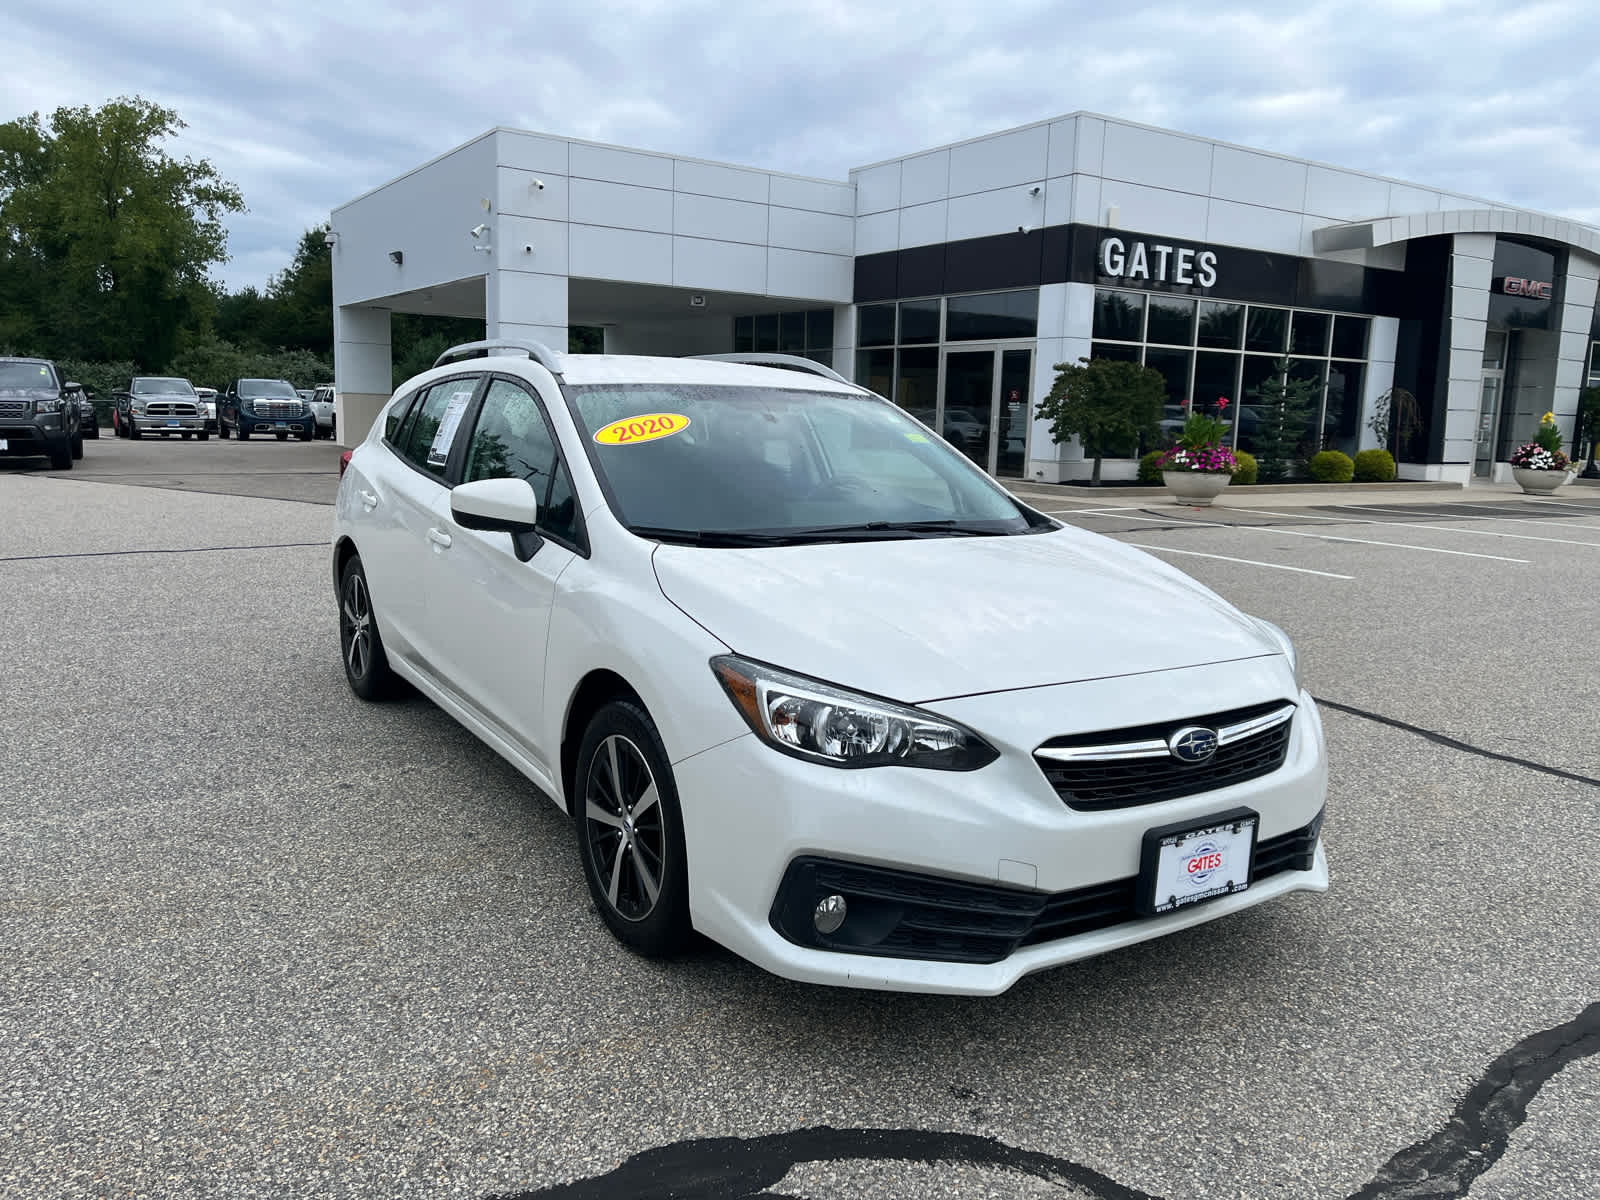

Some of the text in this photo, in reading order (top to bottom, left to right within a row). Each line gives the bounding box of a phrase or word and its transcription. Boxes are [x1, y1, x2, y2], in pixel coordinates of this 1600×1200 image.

[1101, 237, 1217, 288] GATES
[1503, 276, 1553, 300] GMC
[612, 416, 674, 442] 2020
[1187, 852, 1222, 874] GATES
